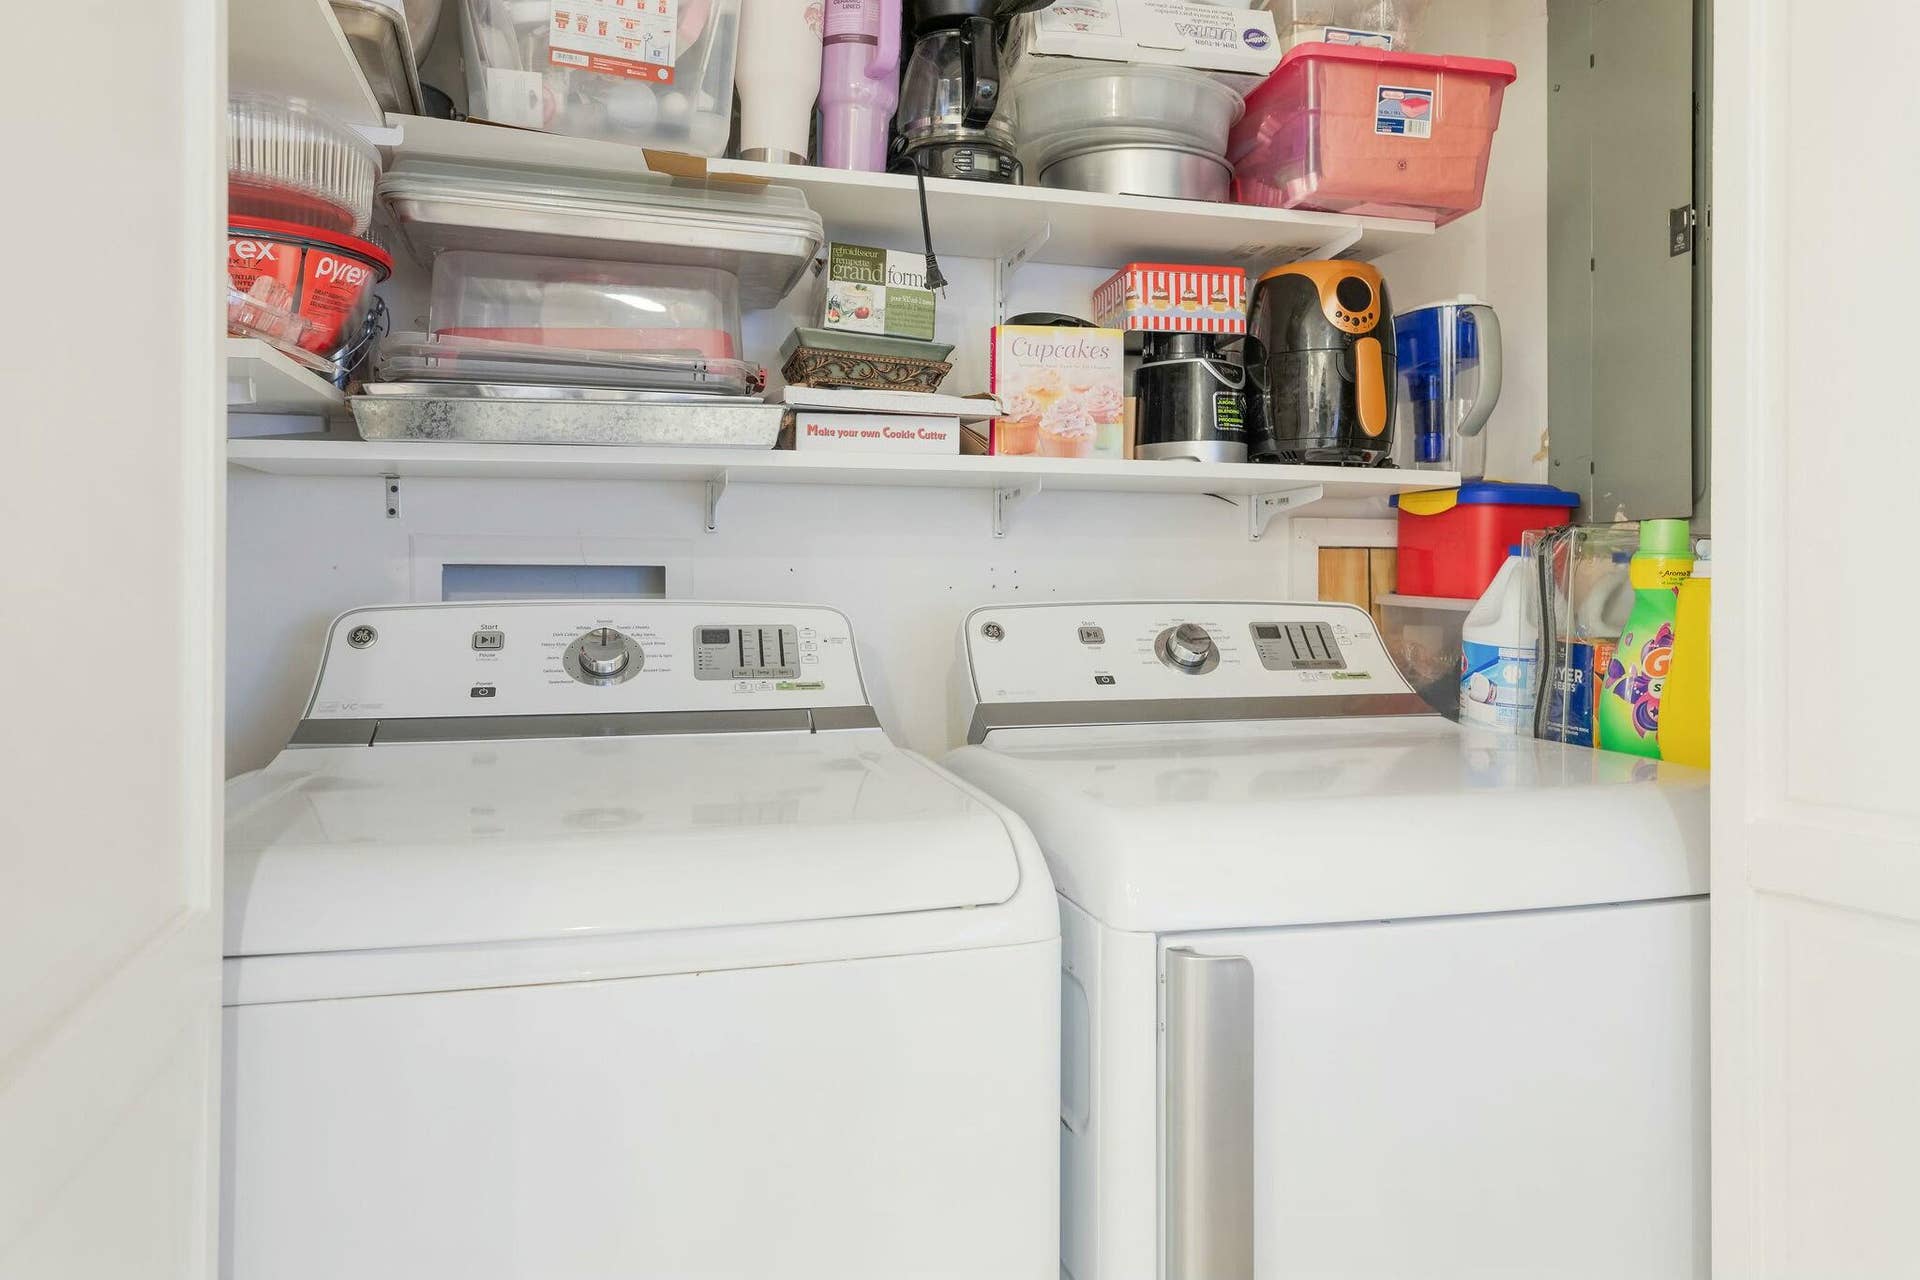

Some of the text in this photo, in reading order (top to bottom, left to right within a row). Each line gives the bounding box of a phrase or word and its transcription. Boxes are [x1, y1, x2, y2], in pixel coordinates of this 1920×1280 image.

[1175, 22, 1238, 42] ULTRA
[228, 240, 276, 261] rex
[315, 257, 369, 286] pyrex
[832, 263, 926, 287] grand form
[1011, 337, 1109, 363] Cupcakes
[807, 424, 946, 440] Make your own Cookie Cutter
[1553, 667, 1583, 684] YER
